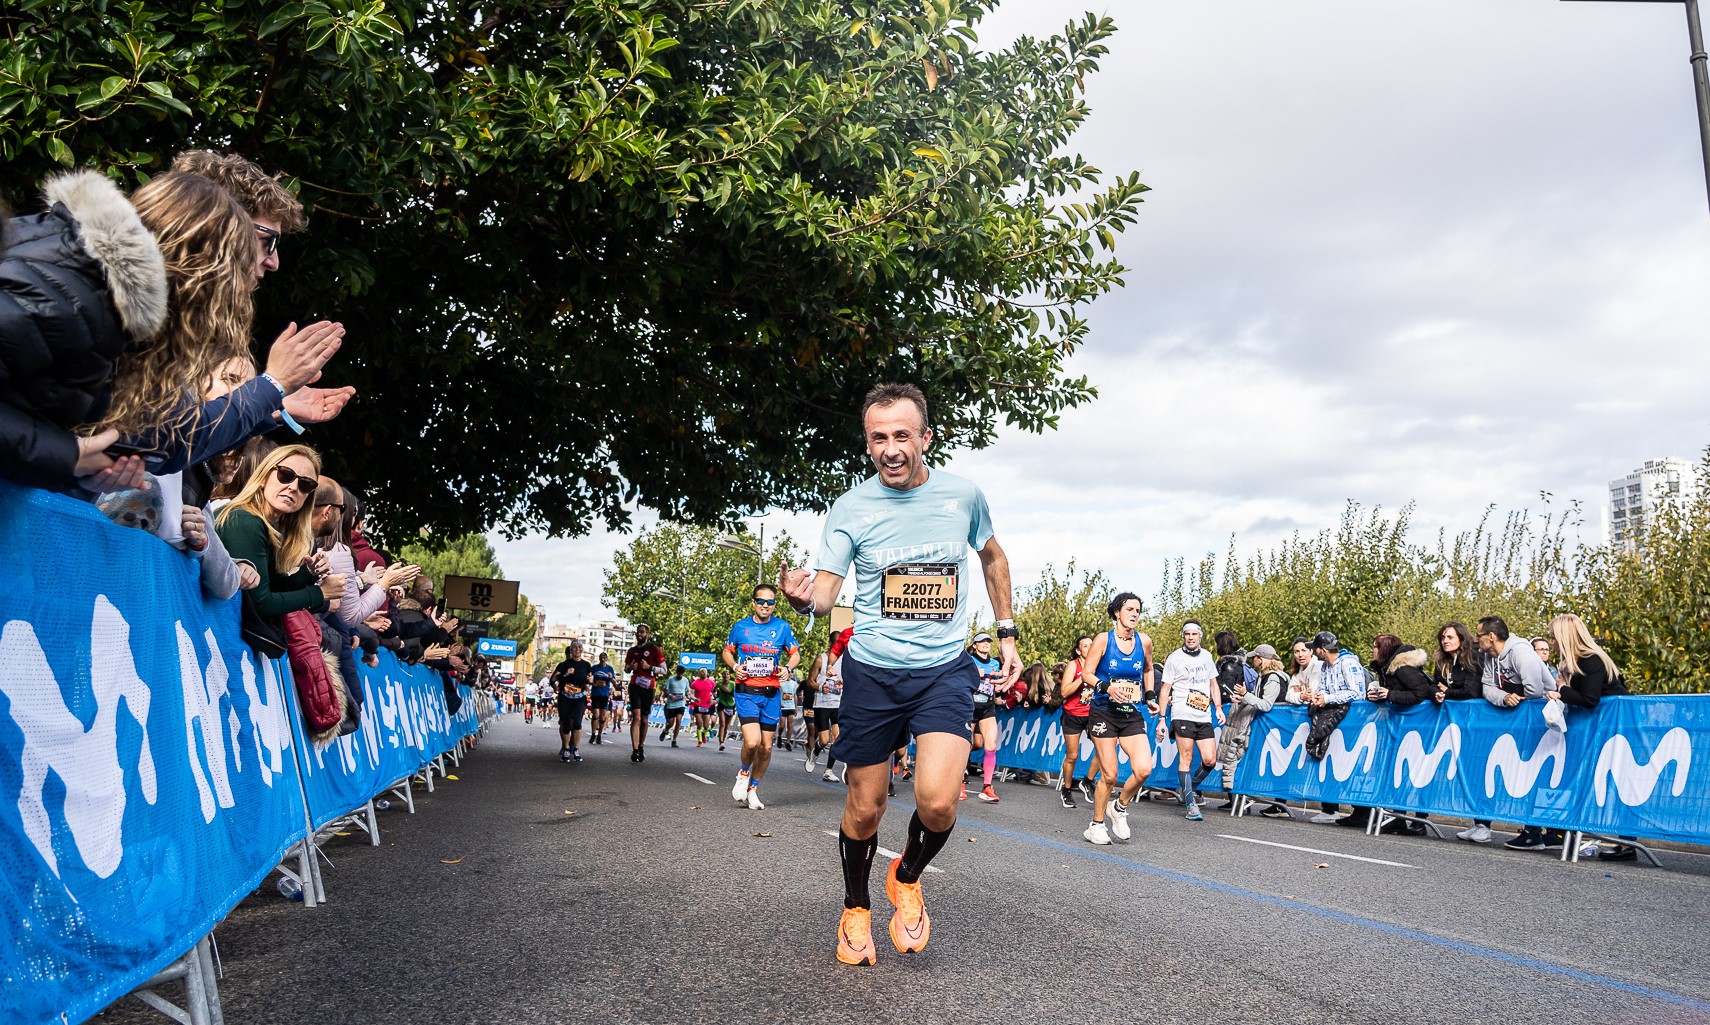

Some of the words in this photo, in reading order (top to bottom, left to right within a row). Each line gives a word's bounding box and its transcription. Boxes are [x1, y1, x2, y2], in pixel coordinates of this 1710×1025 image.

[902, 583, 942, 596] 22077
[886, 596, 955, 610] FRANCESCO
[490, 644, 514, 652] ZURICH
[691, 657, 713, 665] ZURICH
